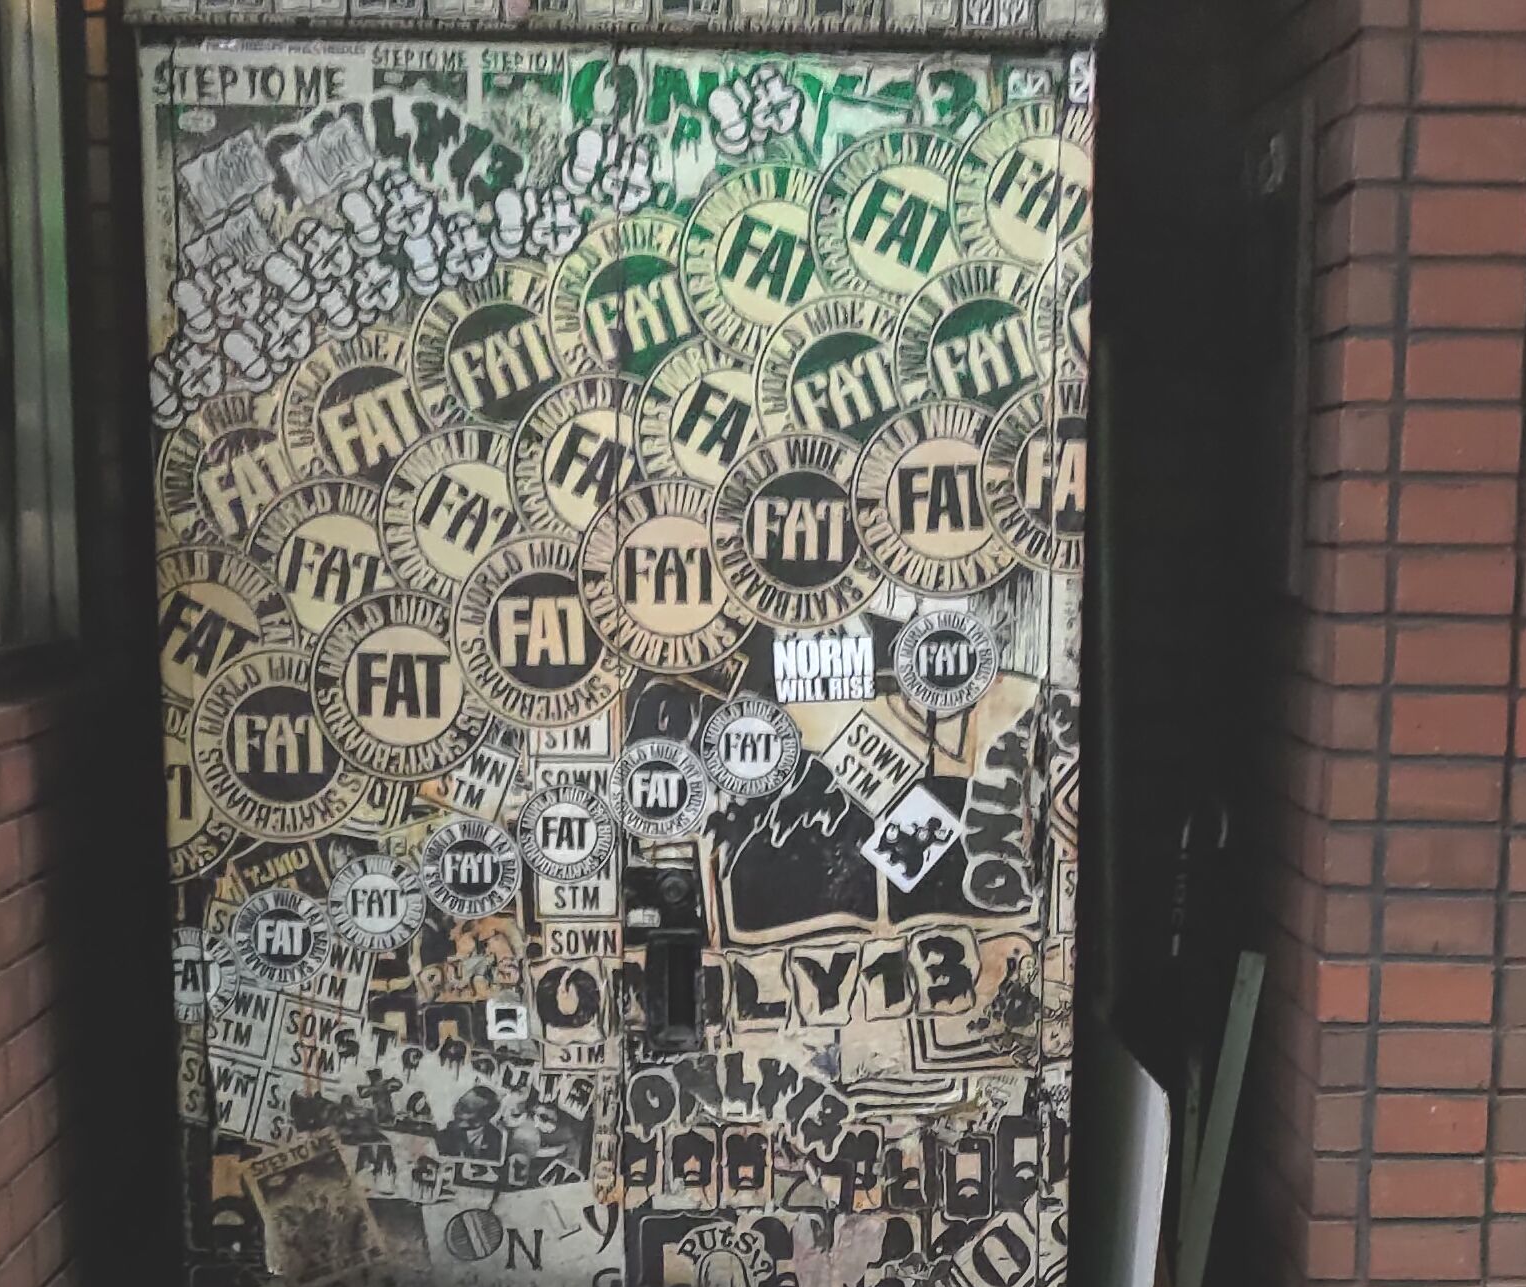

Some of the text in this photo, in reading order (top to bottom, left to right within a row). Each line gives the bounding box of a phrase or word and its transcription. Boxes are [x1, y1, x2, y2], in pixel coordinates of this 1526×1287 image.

[373, 49, 415, 69] STEP
[418, 50, 438, 68] TO
[482, 50, 525, 71] STEP
[549, 49, 564, 71] M
[154, 62, 345, 100] STEP TO ME
[990, 149, 1088, 243] FAT
[851, 178, 951, 274] FAT
[720, 214, 816, 305] FAT
[587, 273, 691, 361] FAT
[450, 319, 554, 409] FAT
[932, 318, 1034, 399] FAT
[794, 346, 898, 432] FAT
[321, 380, 423, 475] FAT
[675, 380, 753, 467] FA
[548, 423, 629, 507] FA
[1026, 438, 1086, 512] FA
[200, 440, 293, 536] FAT
[899, 464, 984, 533] FAT
[419, 475, 519, 553] FAT
[753, 497, 846, 561] FAT
[284, 536, 389, 604] FAT
[528, 540, 580, 577] WID
[625, 546, 713, 604] FAT
[160, 591, 260, 678] FAT
[497, 597, 586, 667] FAT
[268, 654, 312, 687] WID
[773, 637, 874, 679] NORM
[918, 641, 976, 677] FAT
[356, 652, 451, 720] FAT
[777, 676, 876, 702] WILL RISE
[233, 714, 325, 775] FAT
[545, 725, 592, 750] STM
[725, 731, 779, 763] FAT
[847, 723, 911, 786] SOWN
[469, 754, 508, 788] WN
[632, 771, 683, 808] FAT
[835, 754, 882, 799] STM
[541, 816, 591, 850] FAT
[444, 852, 496, 885] FAT
[350, 888, 401, 920] FAT
[554, 885, 601, 911] STM
[257, 918, 307, 956] FAT
[550, 929, 618, 958] SOWN
[330, 943, 366, 976] WN
[233, 990, 270, 1022] WN
[286, 1009, 338, 1045] SOW
[208, 1015, 253, 1048] STM
[290, 1040, 335, 1074] STM
